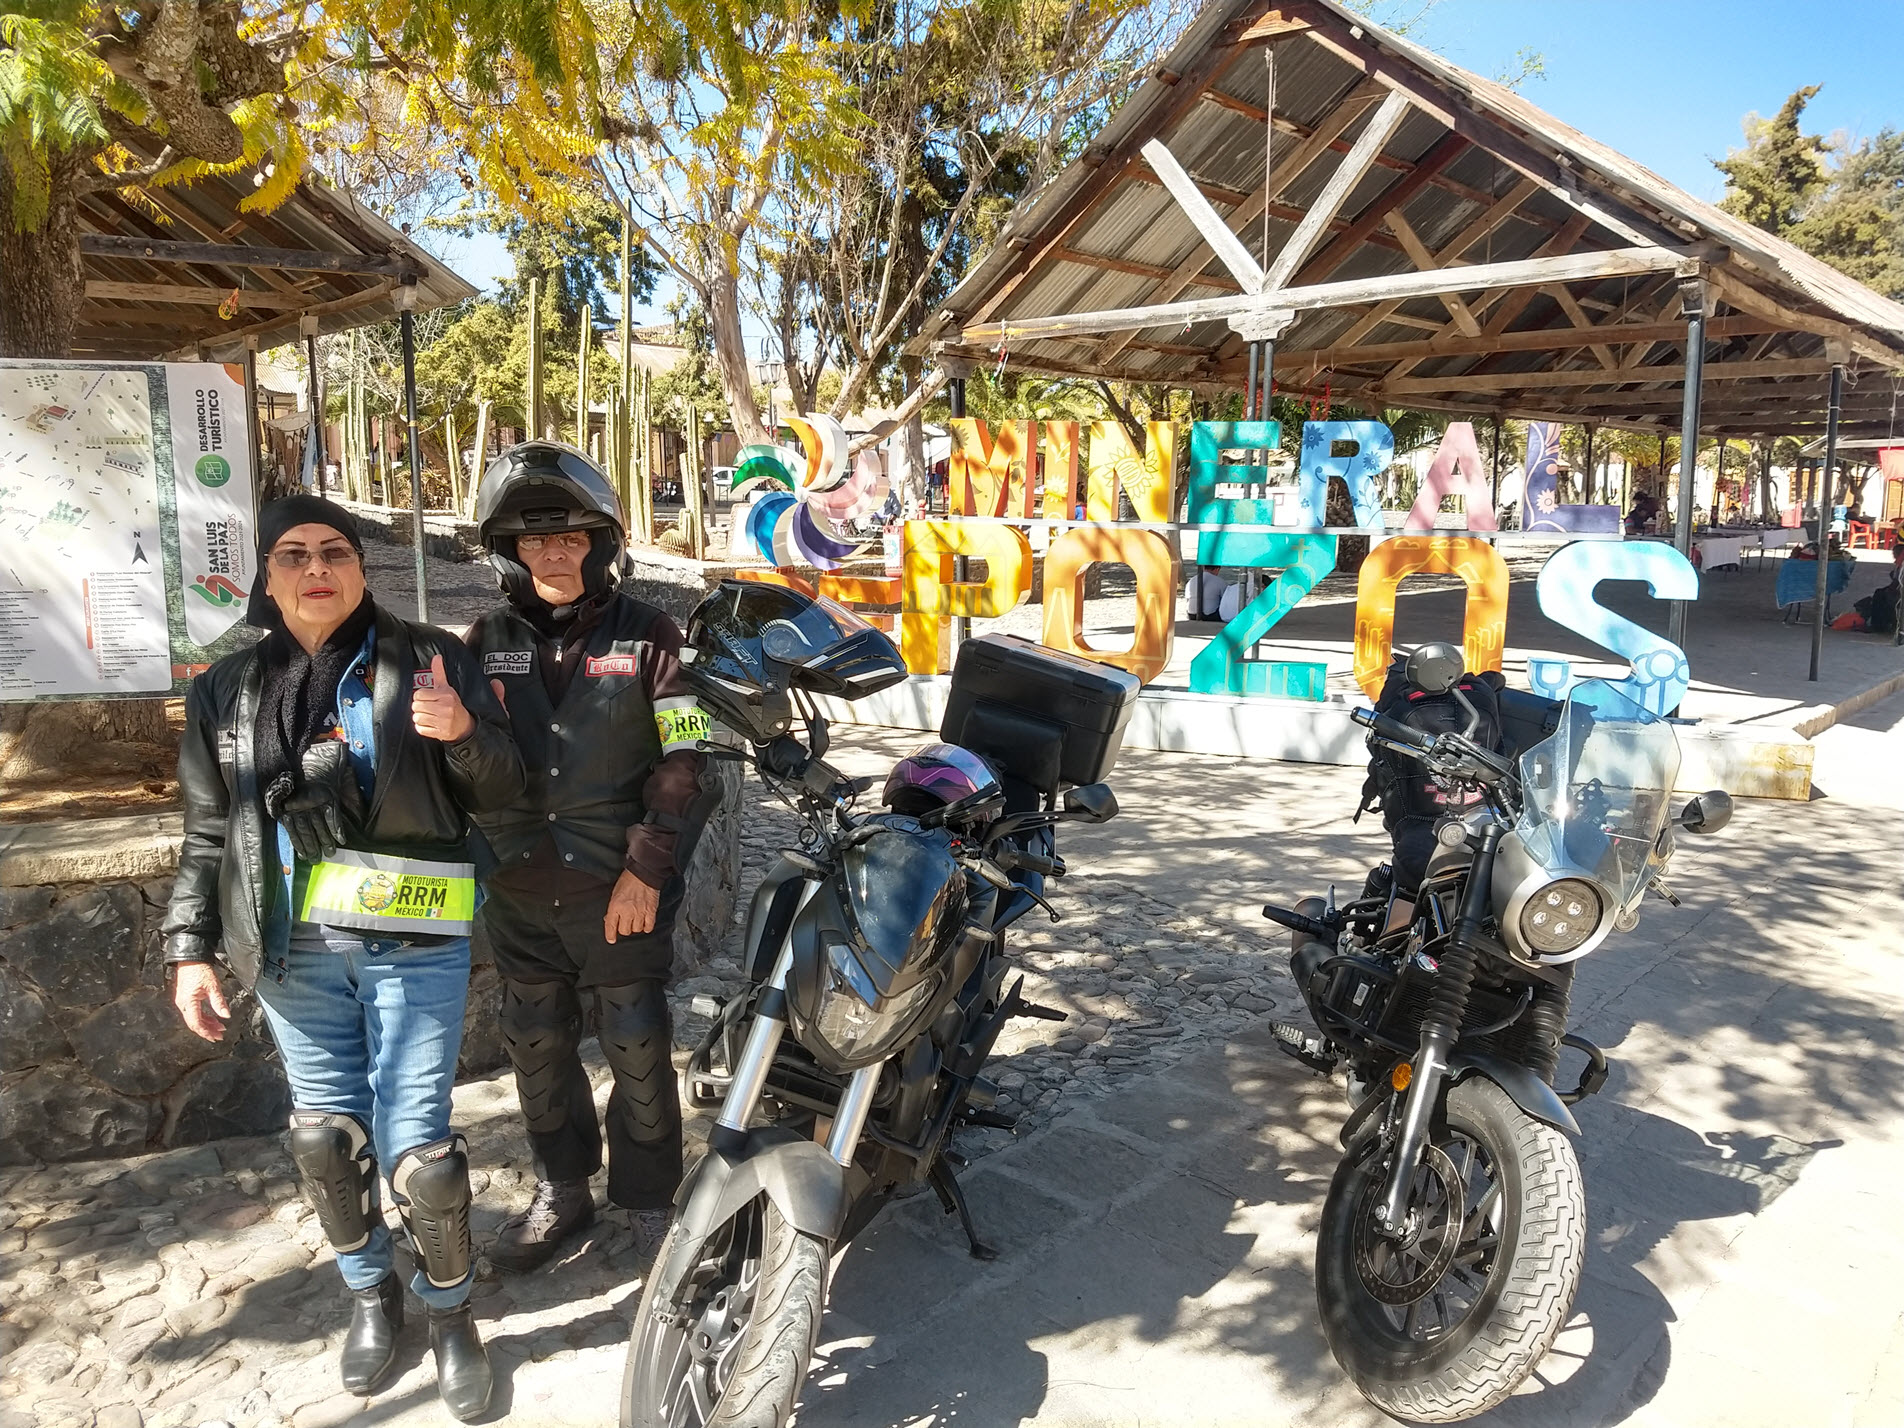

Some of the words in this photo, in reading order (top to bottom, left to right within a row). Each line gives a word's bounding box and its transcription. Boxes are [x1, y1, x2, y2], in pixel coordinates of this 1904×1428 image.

[195, 389, 208, 452] DESARROLLO
[207, 389, 223, 452] TURÍSTICO
[950, 418, 1620, 533] MINERAL
[206, 522, 217, 546] LUIS
[217, 522, 228, 546] PAZ
[228, 513, 237, 546] TODOS
[208, 549, 219, 573] SAN
[219, 547, 228, 560] LA
[230, 549, 240, 582] SOMOS
[221, 561, 229, 573] DE
[902, 519, 1699, 717] POZOS
[713, 622, 758, 664] SHAFT
[485, 663, 528, 674] Presidente
[487, 654, 497, 662] EL
[504, 653, 529, 661] DOC
[675, 715, 711, 732] RRM
[402, 875, 448, 887] MOTOTURISTA
[397, 885, 447, 907] RRM
[395, 906, 424, 917] MÉXICO
